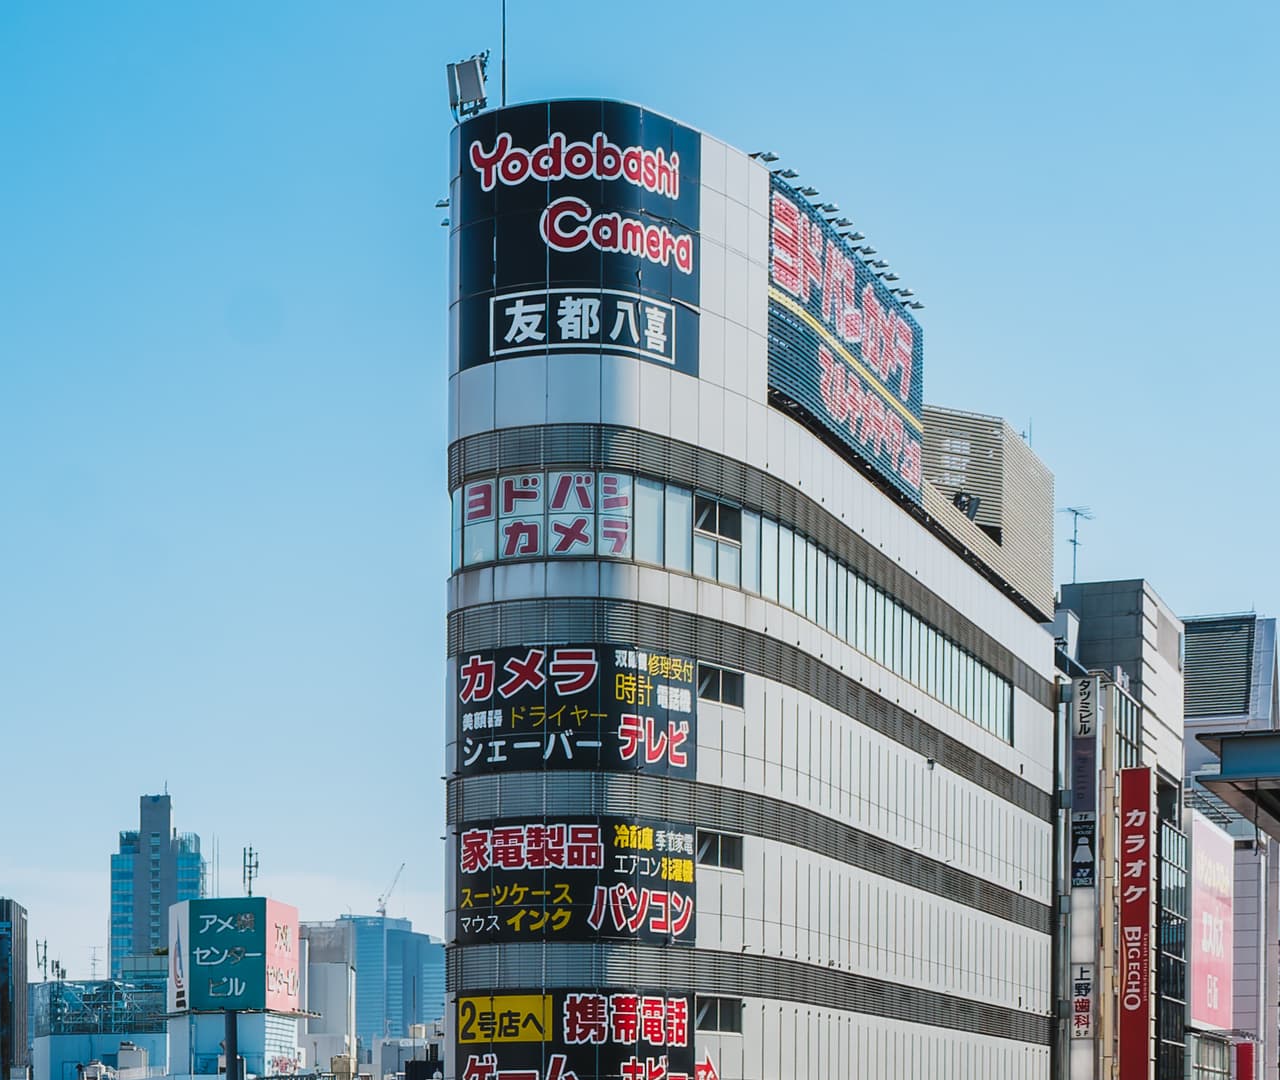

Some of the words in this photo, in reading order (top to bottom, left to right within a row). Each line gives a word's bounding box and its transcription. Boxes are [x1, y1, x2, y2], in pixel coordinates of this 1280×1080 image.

[470, 132, 680, 200] Yodobashi
[540, 196, 693, 274] Camera
[504, 297, 669, 354] 友都八喜
[465, 474, 632, 521] ヨドバシ
[502, 517, 630, 557] カメラ
[460, 649, 599, 704] カメラ
[615, 672, 654, 707] 時計
[648, 653, 694, 683] 修理受付
[510, 705, 608, 729] ドライヤー
[1078, 679, 1091, 736] タツミビル
[463, 729, 602, 766] シェーバー
[618, 713, 690, 768] テレビ
[460, 825, 605, 874] 家電製品
[614, 855, 660, 877] エアコン
[1123, 808, 1148, 904] カラオケ
[460, 883, 573, 909] スーツケース
[587, 882, 694, 936] パソコン
[198, 913, 256, 934] アメ横
[460, 915, 501, 933] マウス
[506, 907, 573, 932] インク
[1124, 926, 1142, 958] BIG
[193, 946, 263, 967] センター
[208, 976, 246, 998] ビル
[1074, 966, 1091, 1029] 上野歯科
[1123, 961, 1142, 1011] ECHO
[460, 1000, 545, 1041] 2号店へ
[563, 993, 689, 1047] 携帯電話
